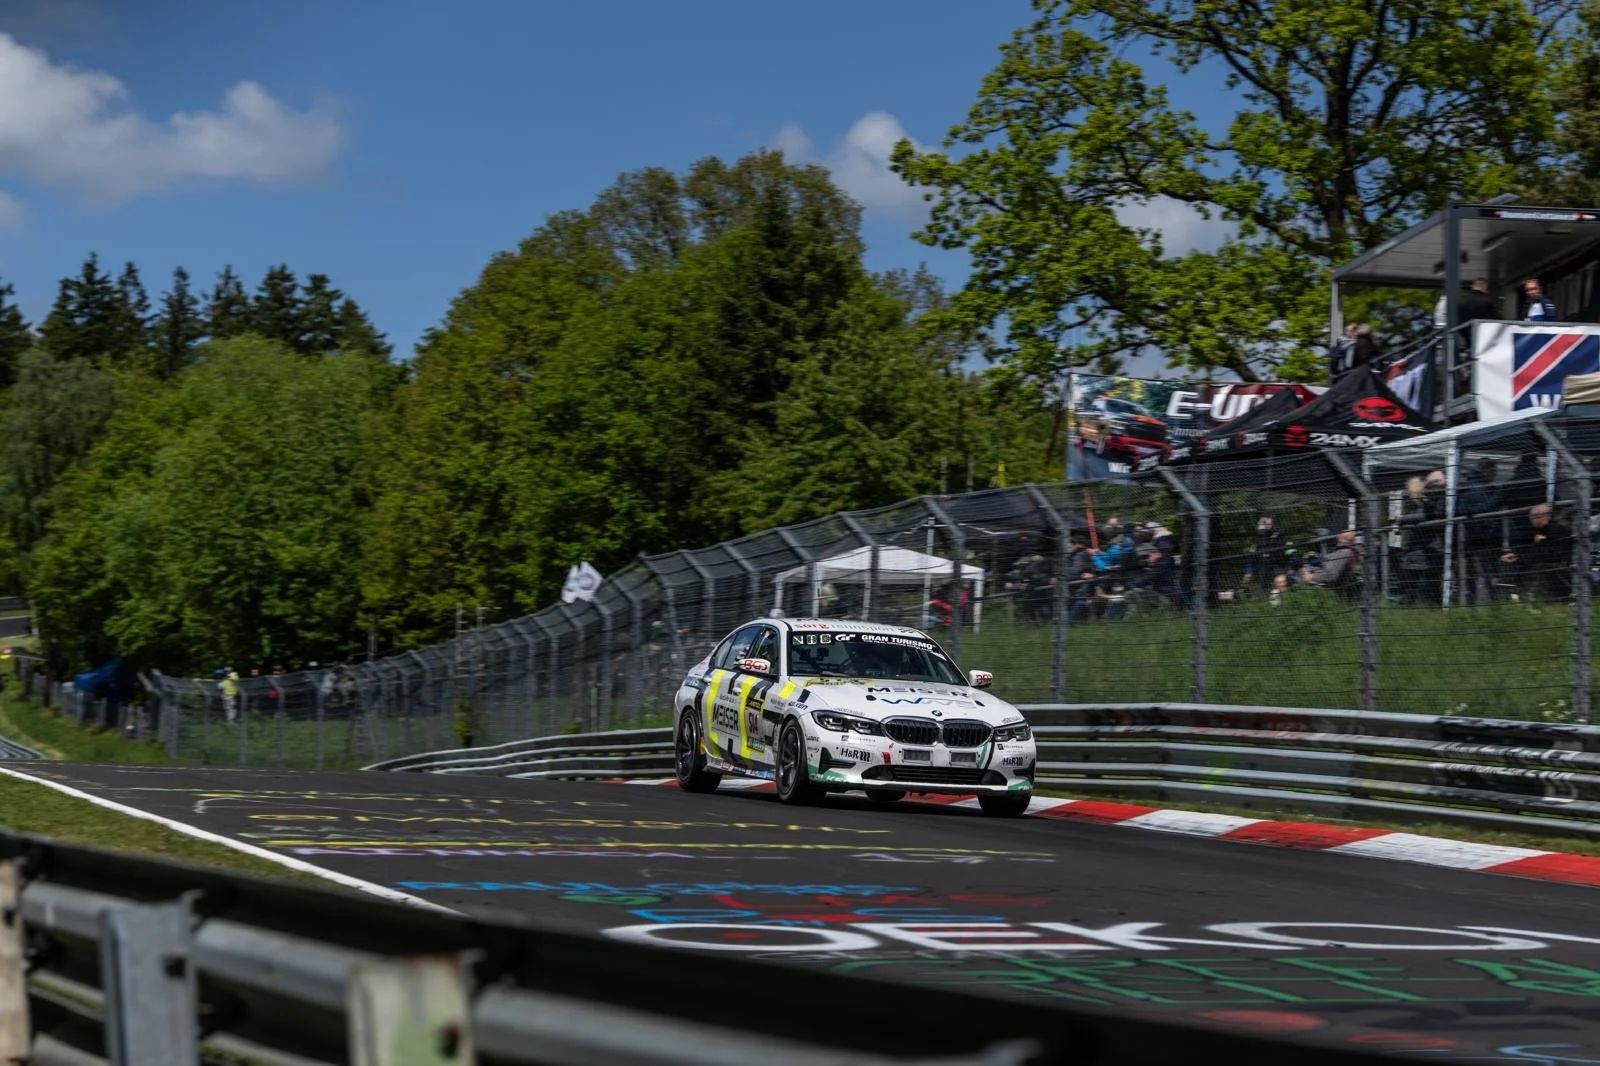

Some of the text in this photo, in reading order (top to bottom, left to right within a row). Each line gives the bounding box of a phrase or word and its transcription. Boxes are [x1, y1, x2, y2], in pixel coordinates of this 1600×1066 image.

[1309, 432, 1382, 447] 24MX
[861, 634, 889, 642] GRAN
[891, 637, 934, 650] TURISMO
[712, 703, 739, 732] MEISER
[841, 747, 858, 760] H&R
